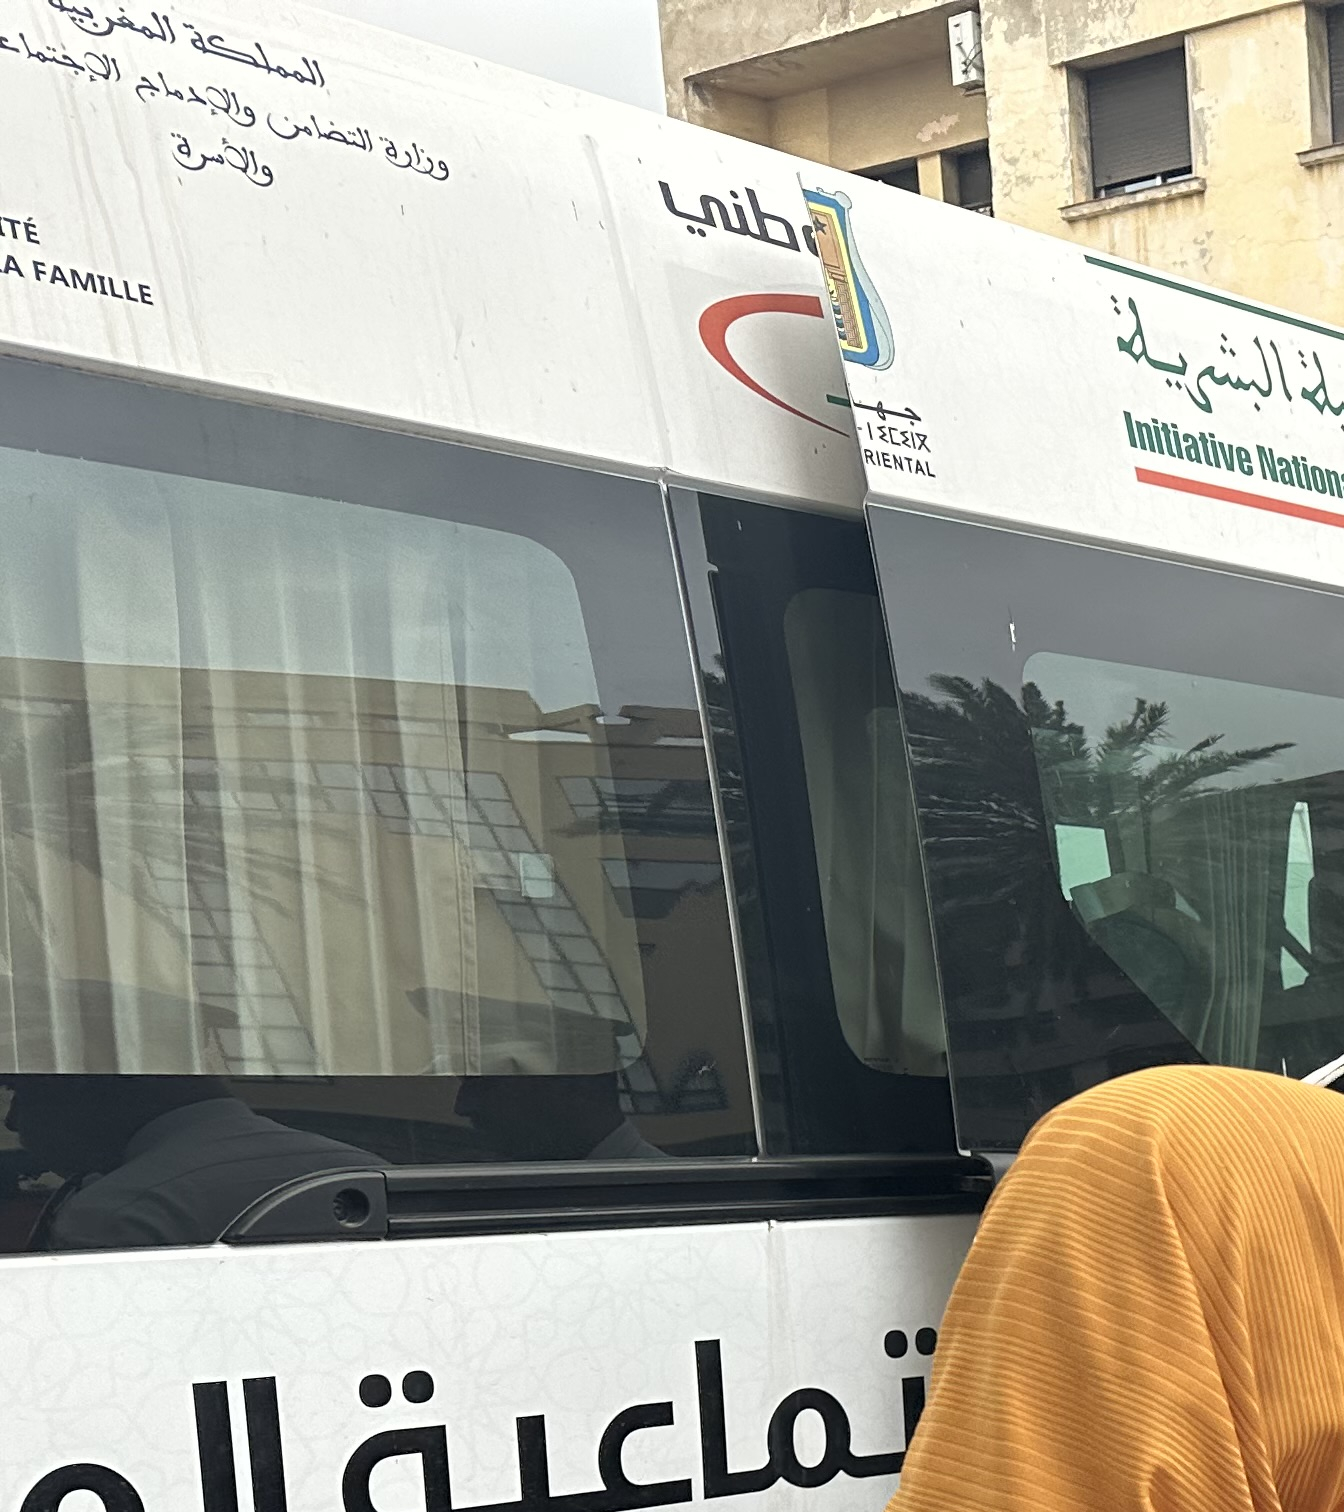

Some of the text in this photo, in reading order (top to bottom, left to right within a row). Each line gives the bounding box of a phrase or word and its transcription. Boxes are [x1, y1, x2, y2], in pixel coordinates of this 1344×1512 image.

[0, 32, 121, 83] الإجتماع
[182, 22, 326, 88] المملكة
[266, 110, 374, 153] التضامن
[380, 133, 451, 182] وزارة
[0, 215, 40, 245] ITÉ
[0, 254, 154, 306] A FAMILLE
[1110, 294, 1294, 414] البشرية
[863, 448, 937, 478] RIENTAL
[1122, 410, 1254, 477] Initiative
